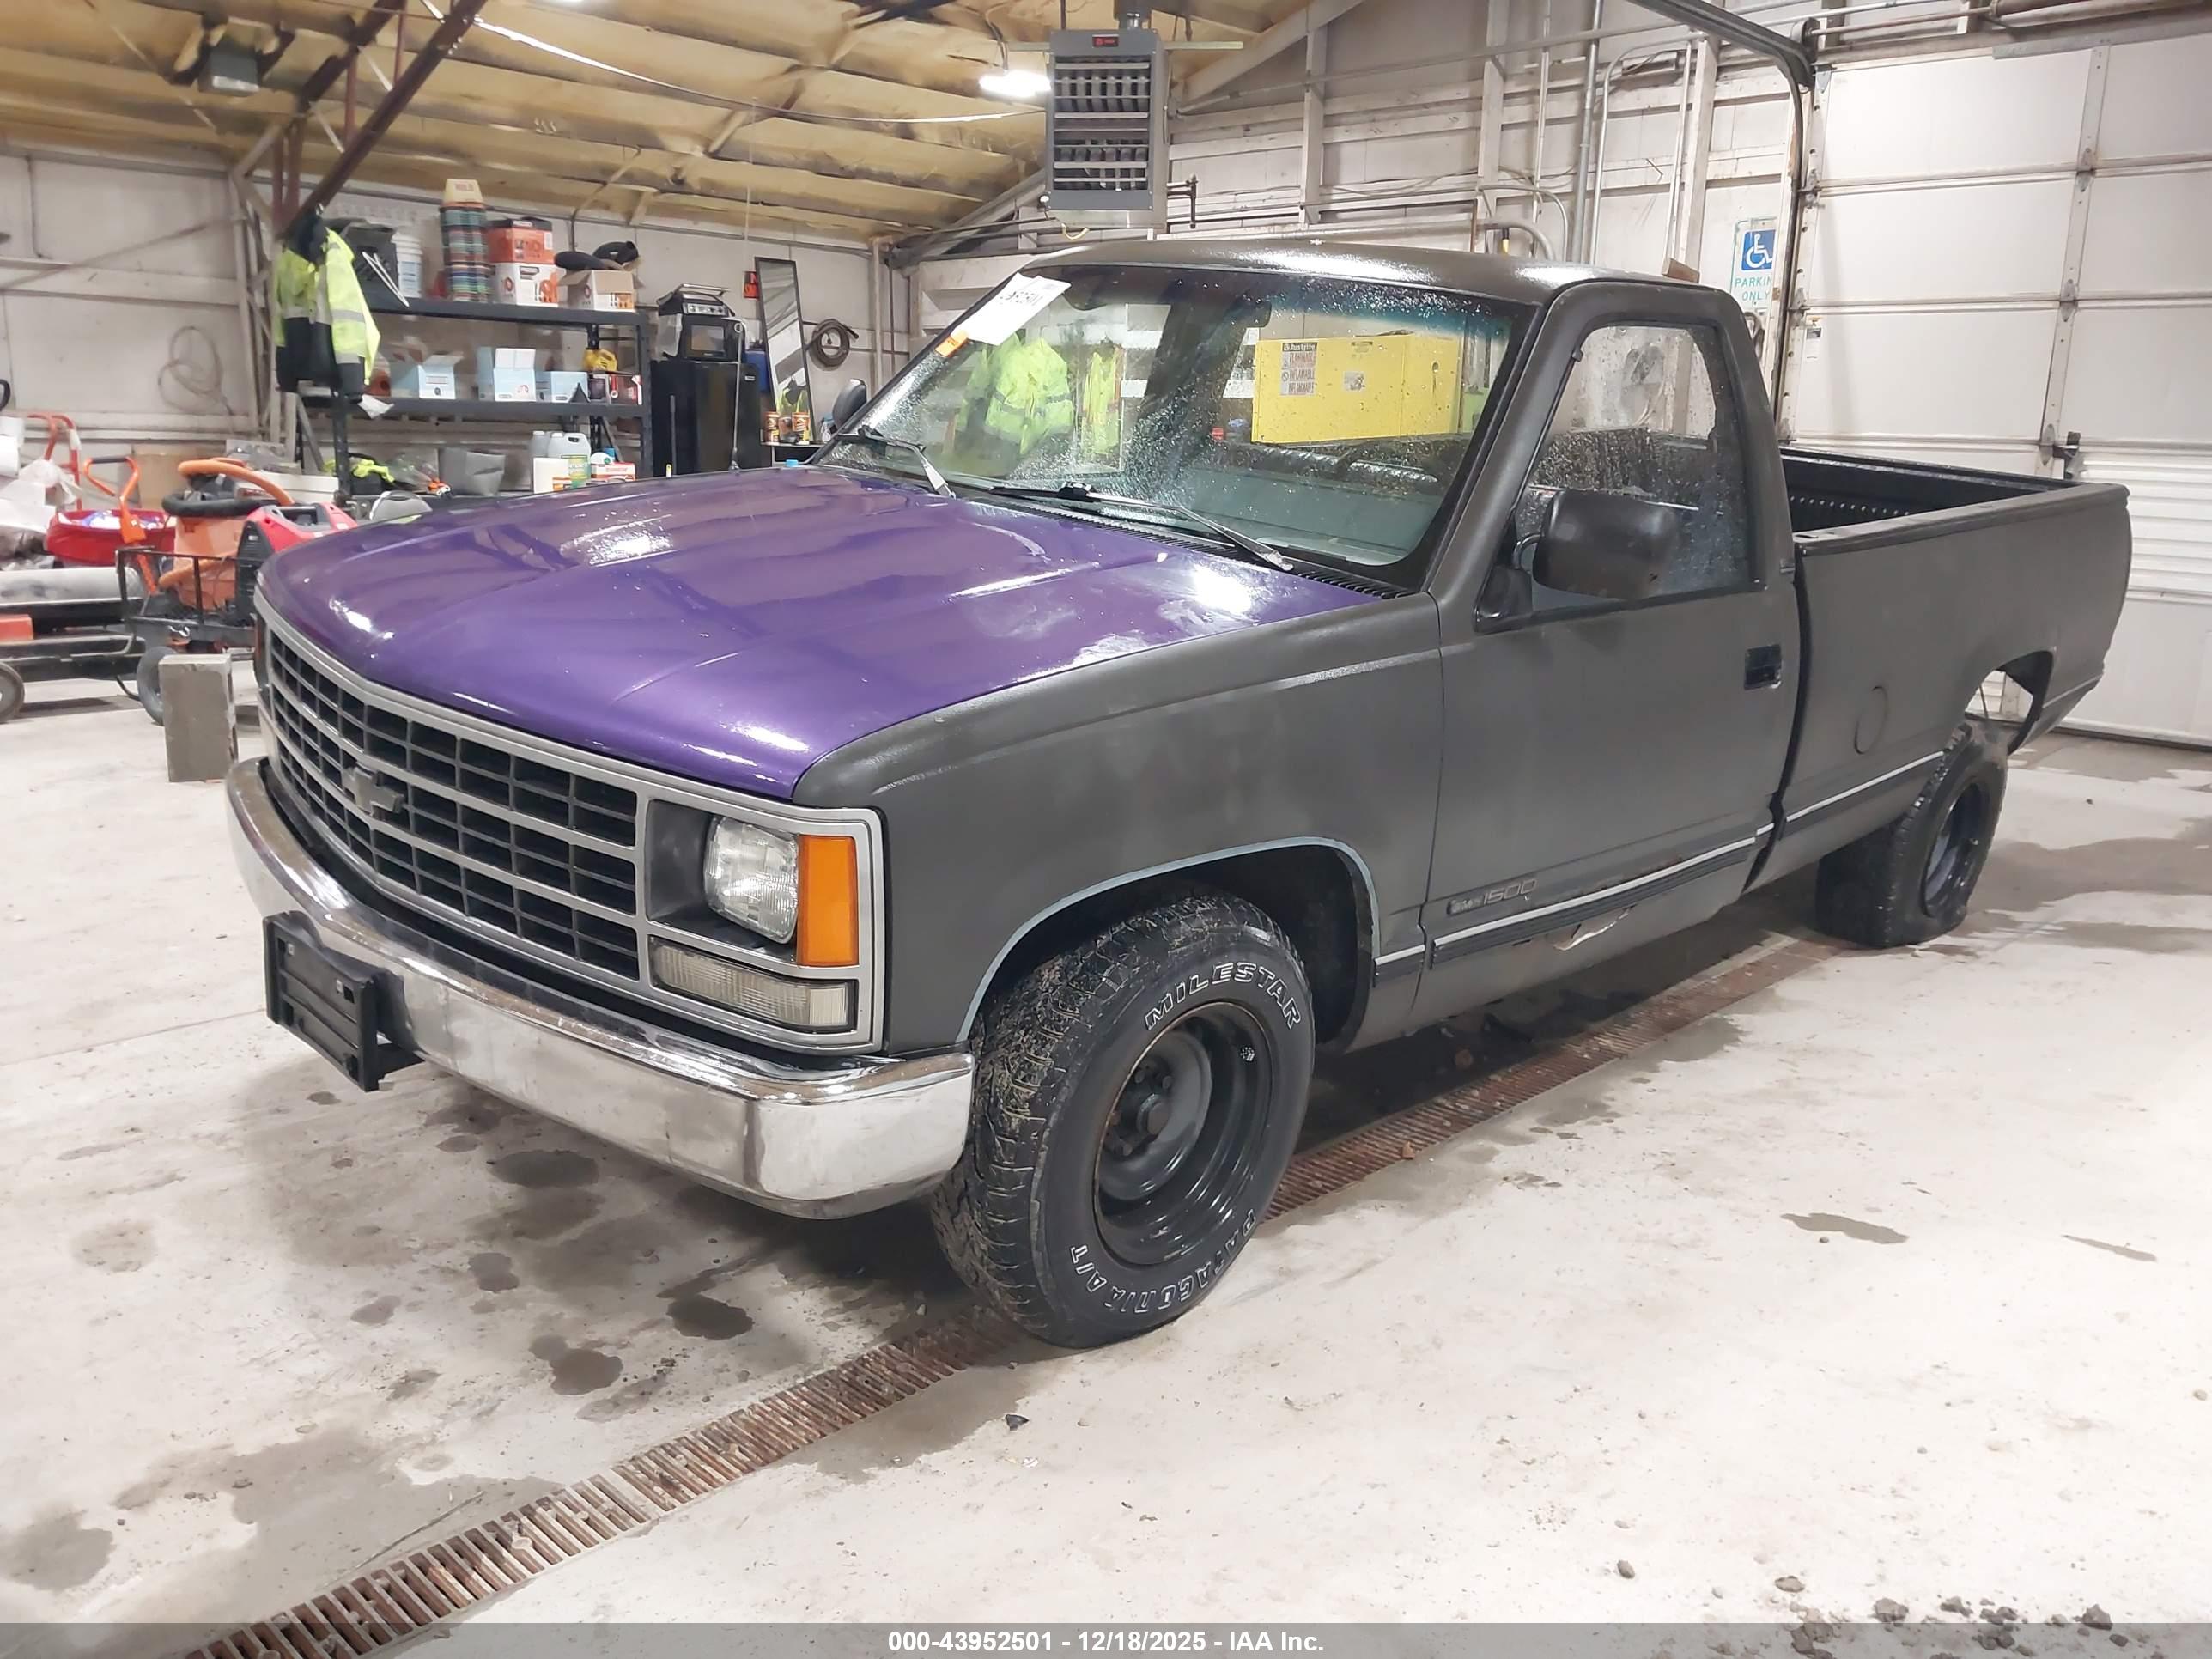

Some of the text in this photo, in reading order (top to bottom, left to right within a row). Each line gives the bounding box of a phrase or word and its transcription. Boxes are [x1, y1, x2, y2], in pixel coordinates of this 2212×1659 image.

[1742, 290, 1771, 301] ONLY
[1483, 878, 1537, 905] 1500
[1145, 962, 1301, 1030] MILESTAR
[1103, 1208, 1256, 1313] PATAGONIA
